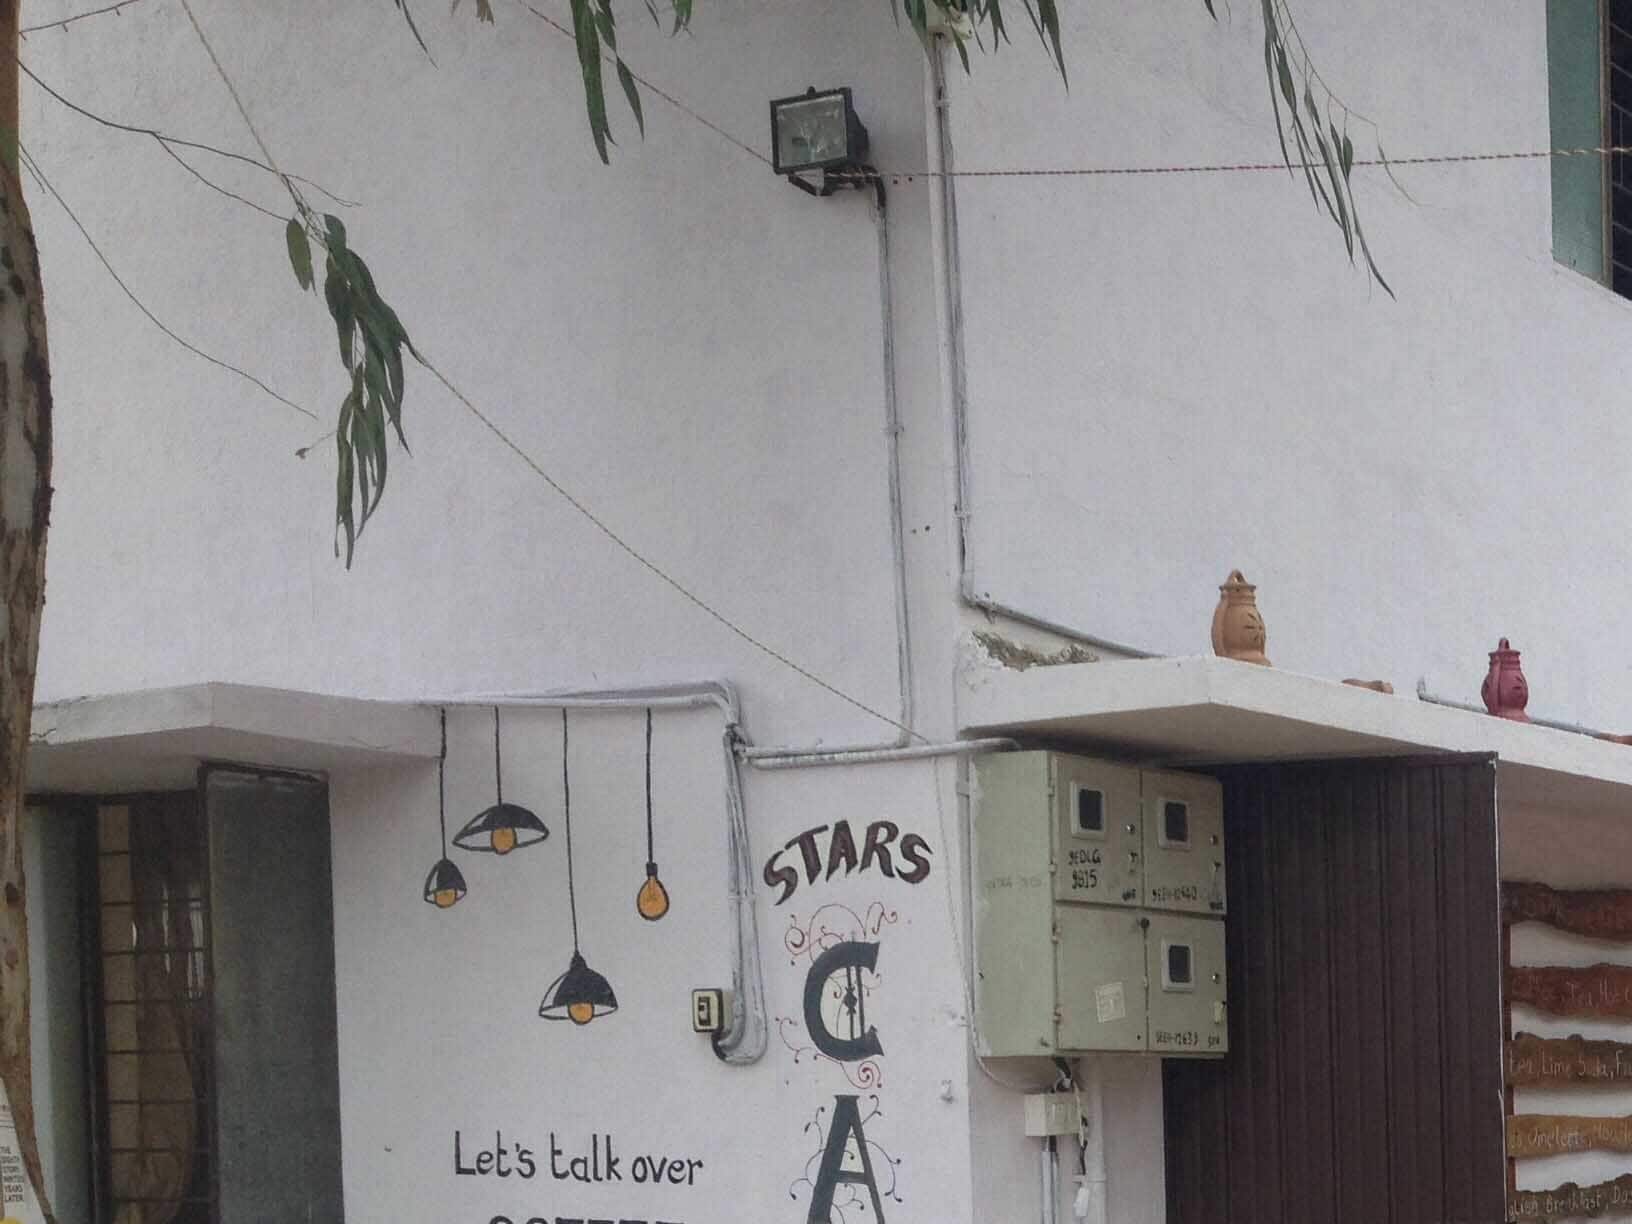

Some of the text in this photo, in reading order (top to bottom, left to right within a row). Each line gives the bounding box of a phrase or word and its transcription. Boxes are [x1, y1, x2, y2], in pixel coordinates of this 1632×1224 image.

[763, 820, 932, 905] STARS
[455, 1129, 704, 1186] Let's talk over
